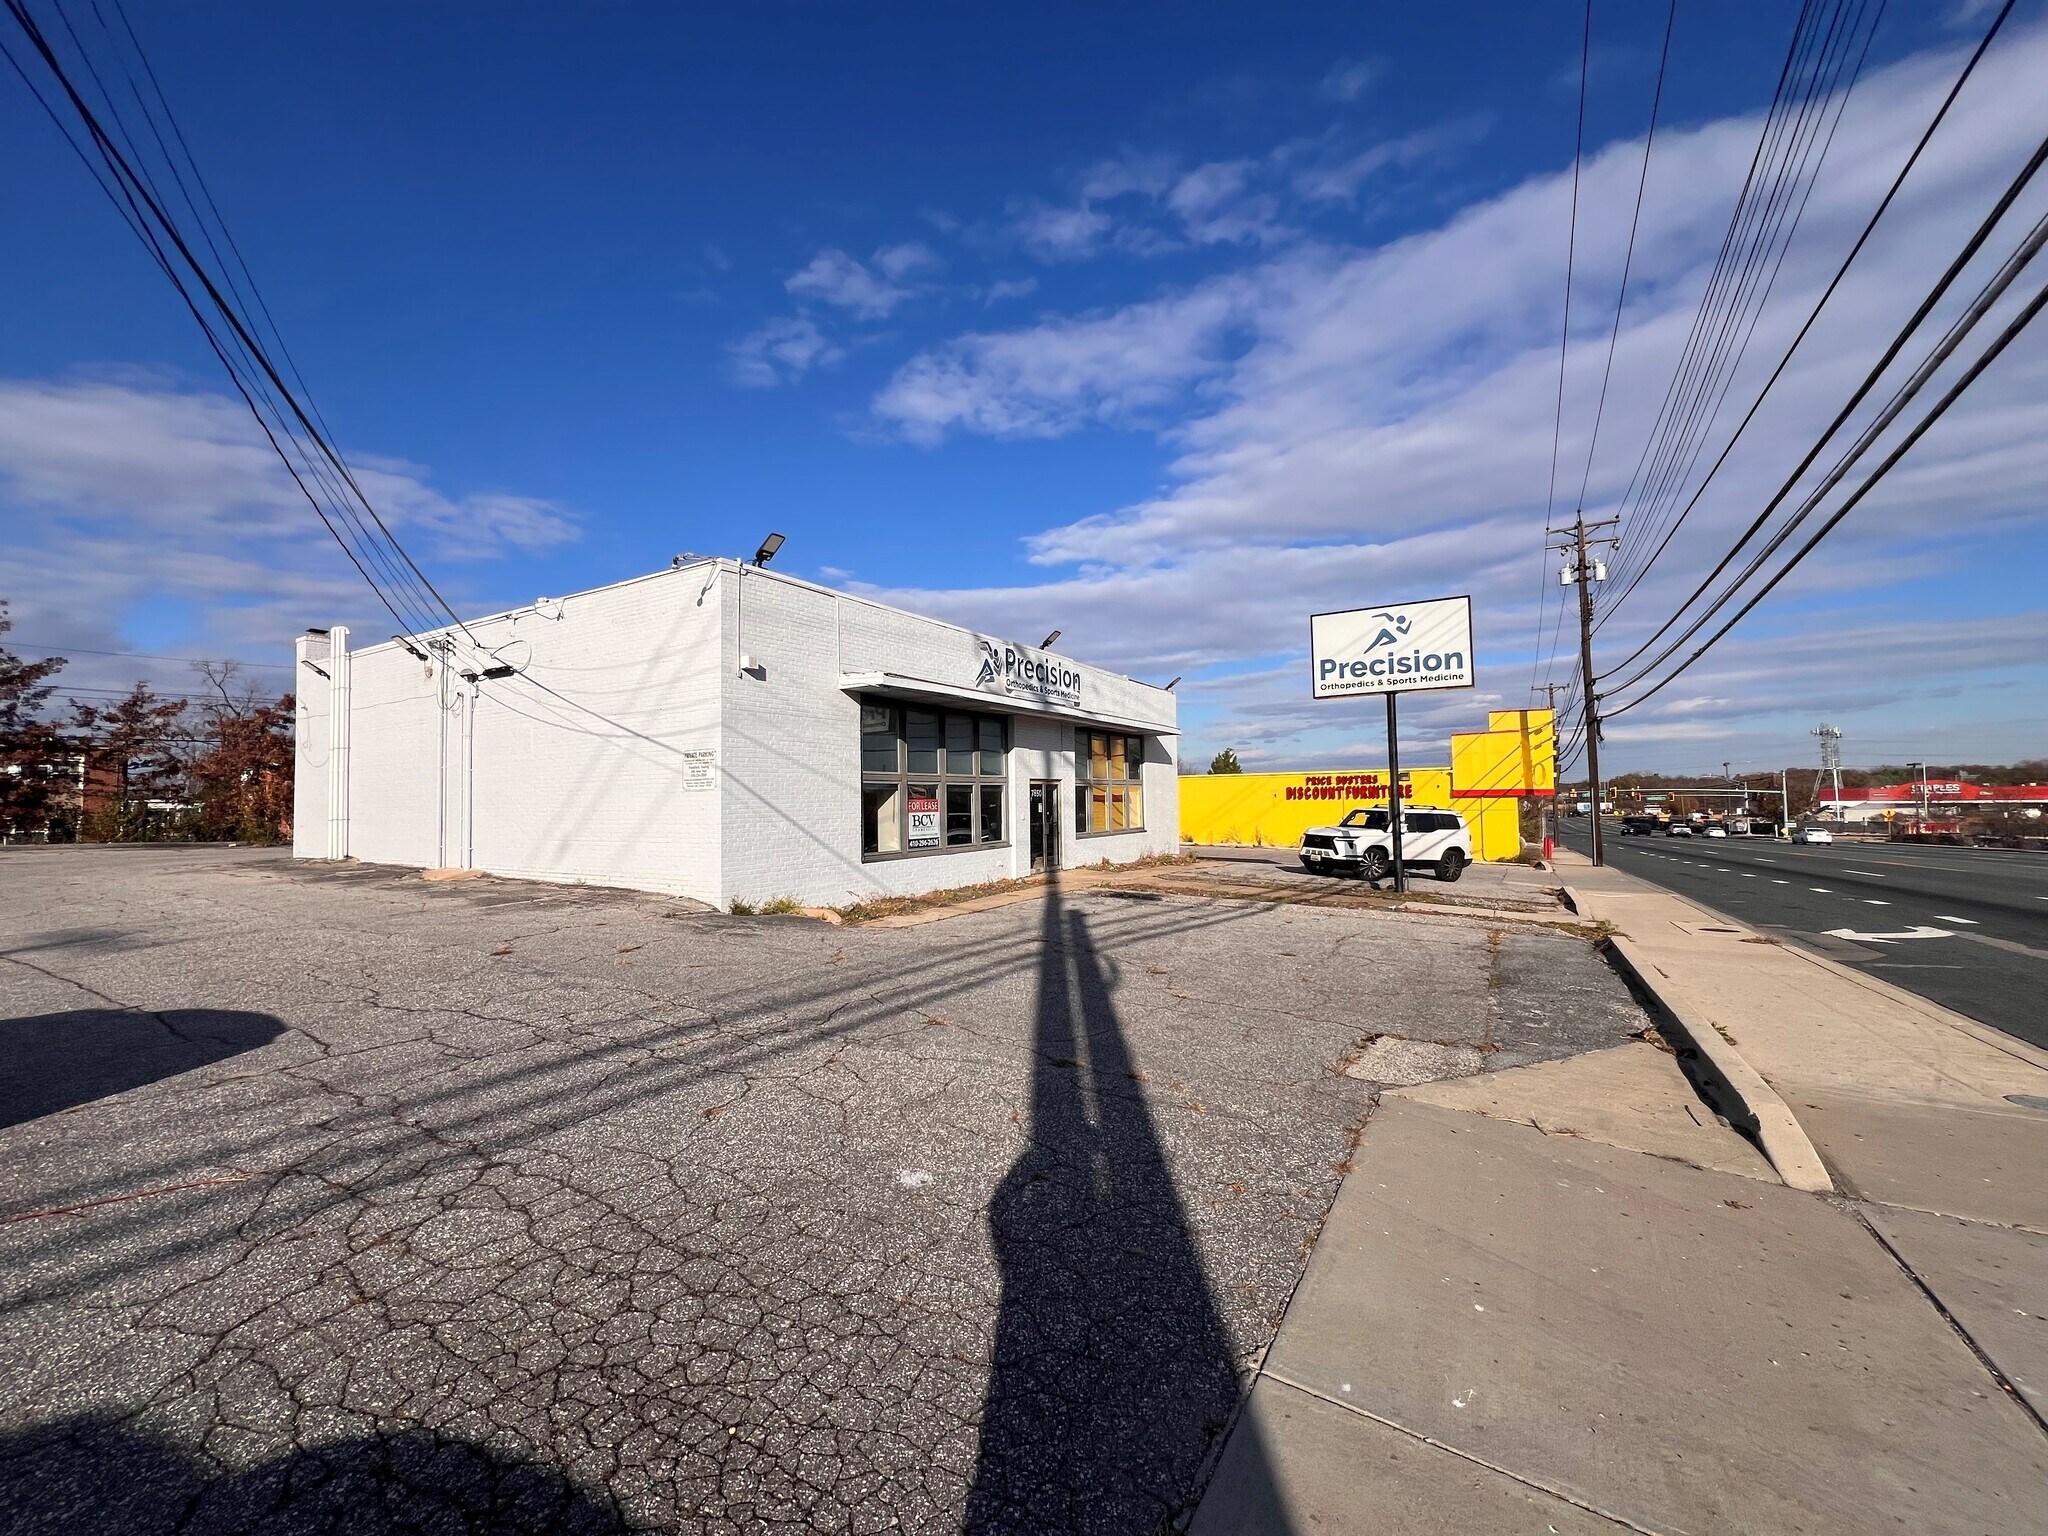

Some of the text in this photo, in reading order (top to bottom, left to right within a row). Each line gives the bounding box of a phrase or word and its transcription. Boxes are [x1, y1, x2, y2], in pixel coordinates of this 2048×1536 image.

[1005, 647, 1081, 691] Precision
[1320, 649, 1463, 681] Precision
[1005, 678, 1080, 701] Orthopedics & Sports Medicine
[1320, 680, 1375, 691] Orthopedics
[1386, 676, 1417, 686] Sports
[1420, 673, 1464, 683] Medicine
[1305, 775, 1378, 786] PRICE BUSTERS
[1911, 783, 1960, 792] STAPLES
[1286, 784, 1413, 800] DISCOUNT FURNITRE
[909, 801, 938, 811] FOR LEASE
[912, 814, 936, 827] BCV
